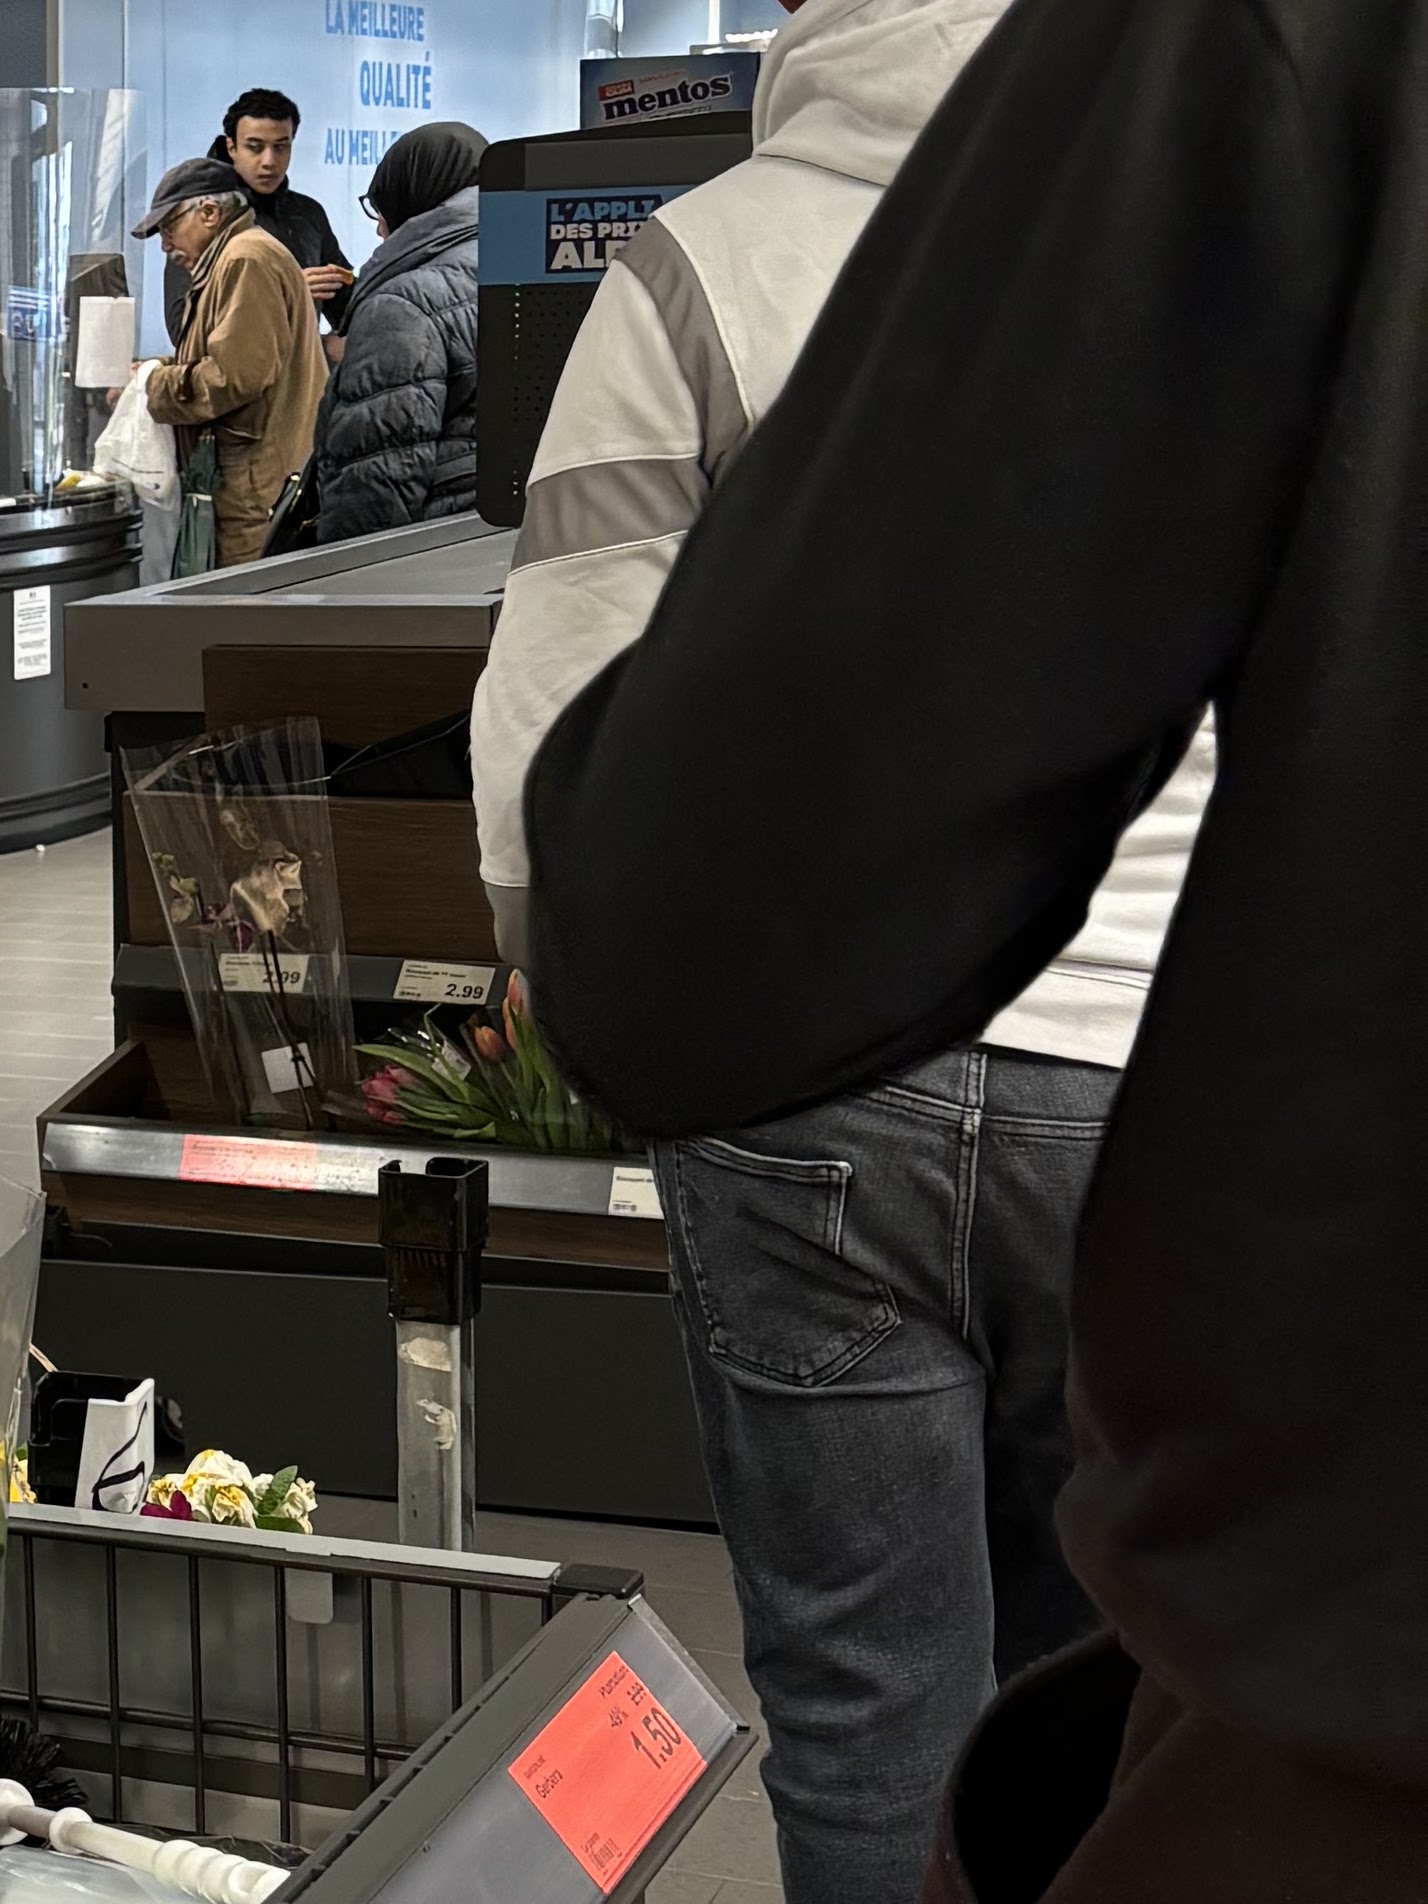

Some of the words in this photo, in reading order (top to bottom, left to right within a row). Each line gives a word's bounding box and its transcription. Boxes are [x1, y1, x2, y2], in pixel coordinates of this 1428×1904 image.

[348, 0, 425, 42] MEILLEURE
[360, 51, 431, 110] QUALITÉ
[603, 74, 732, 121] mentos
[324, 128, 344, 165] AU
[348, 129, 399, 166] MEILL
[550, 223, 593, 240] DES
[262, 971, 302, 984] 299
[445, 983, 484, 999] 2.99
[630, 1706, 683, 1770] 1.50
